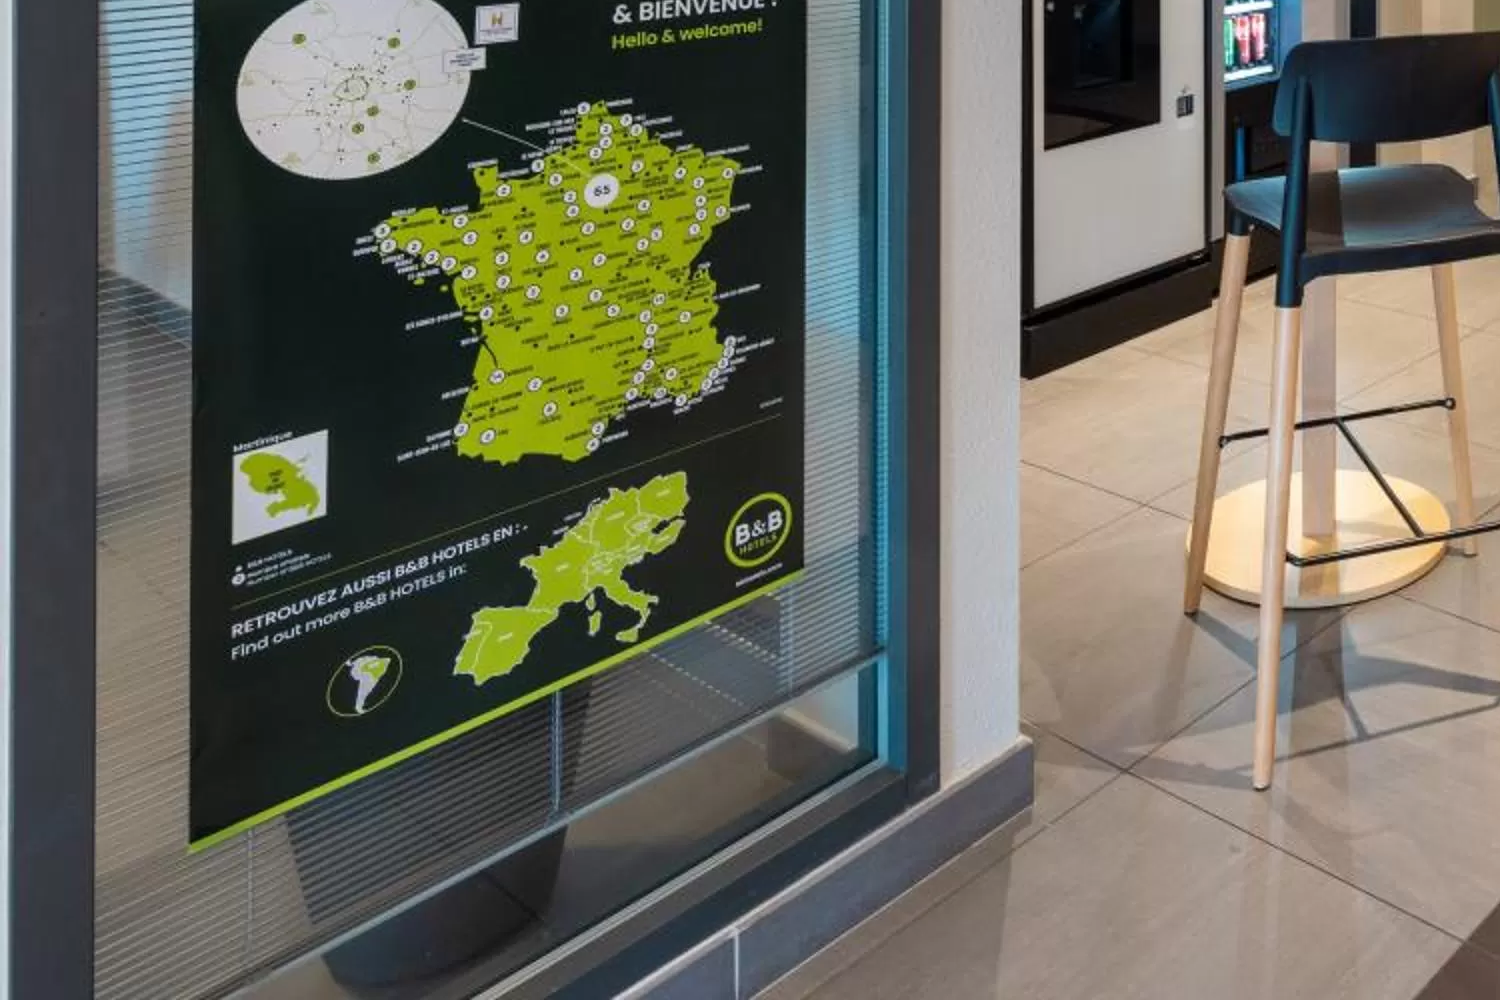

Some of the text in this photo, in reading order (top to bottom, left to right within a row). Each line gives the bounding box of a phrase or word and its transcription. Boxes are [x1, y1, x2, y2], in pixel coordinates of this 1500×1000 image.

[611, 17, 764, 49] Hello & welcome!
[613, 4, 632, 24] &
[735, 509, 783, 547] B&B
[231, 589, 337, 639] RETROUVEZ
[341, 569, 391, 598] AUSSI
[395, 555, 429, 578] B&B
[432, 533, 491, 564] HOTELS
[231, 636, 269, 660] Find
[272, 623, 302, 644] out
[305, 608, 350, 632] more
[353, 592, 387, 613] B&B
[390, 569, 446, 599] HOTELS
